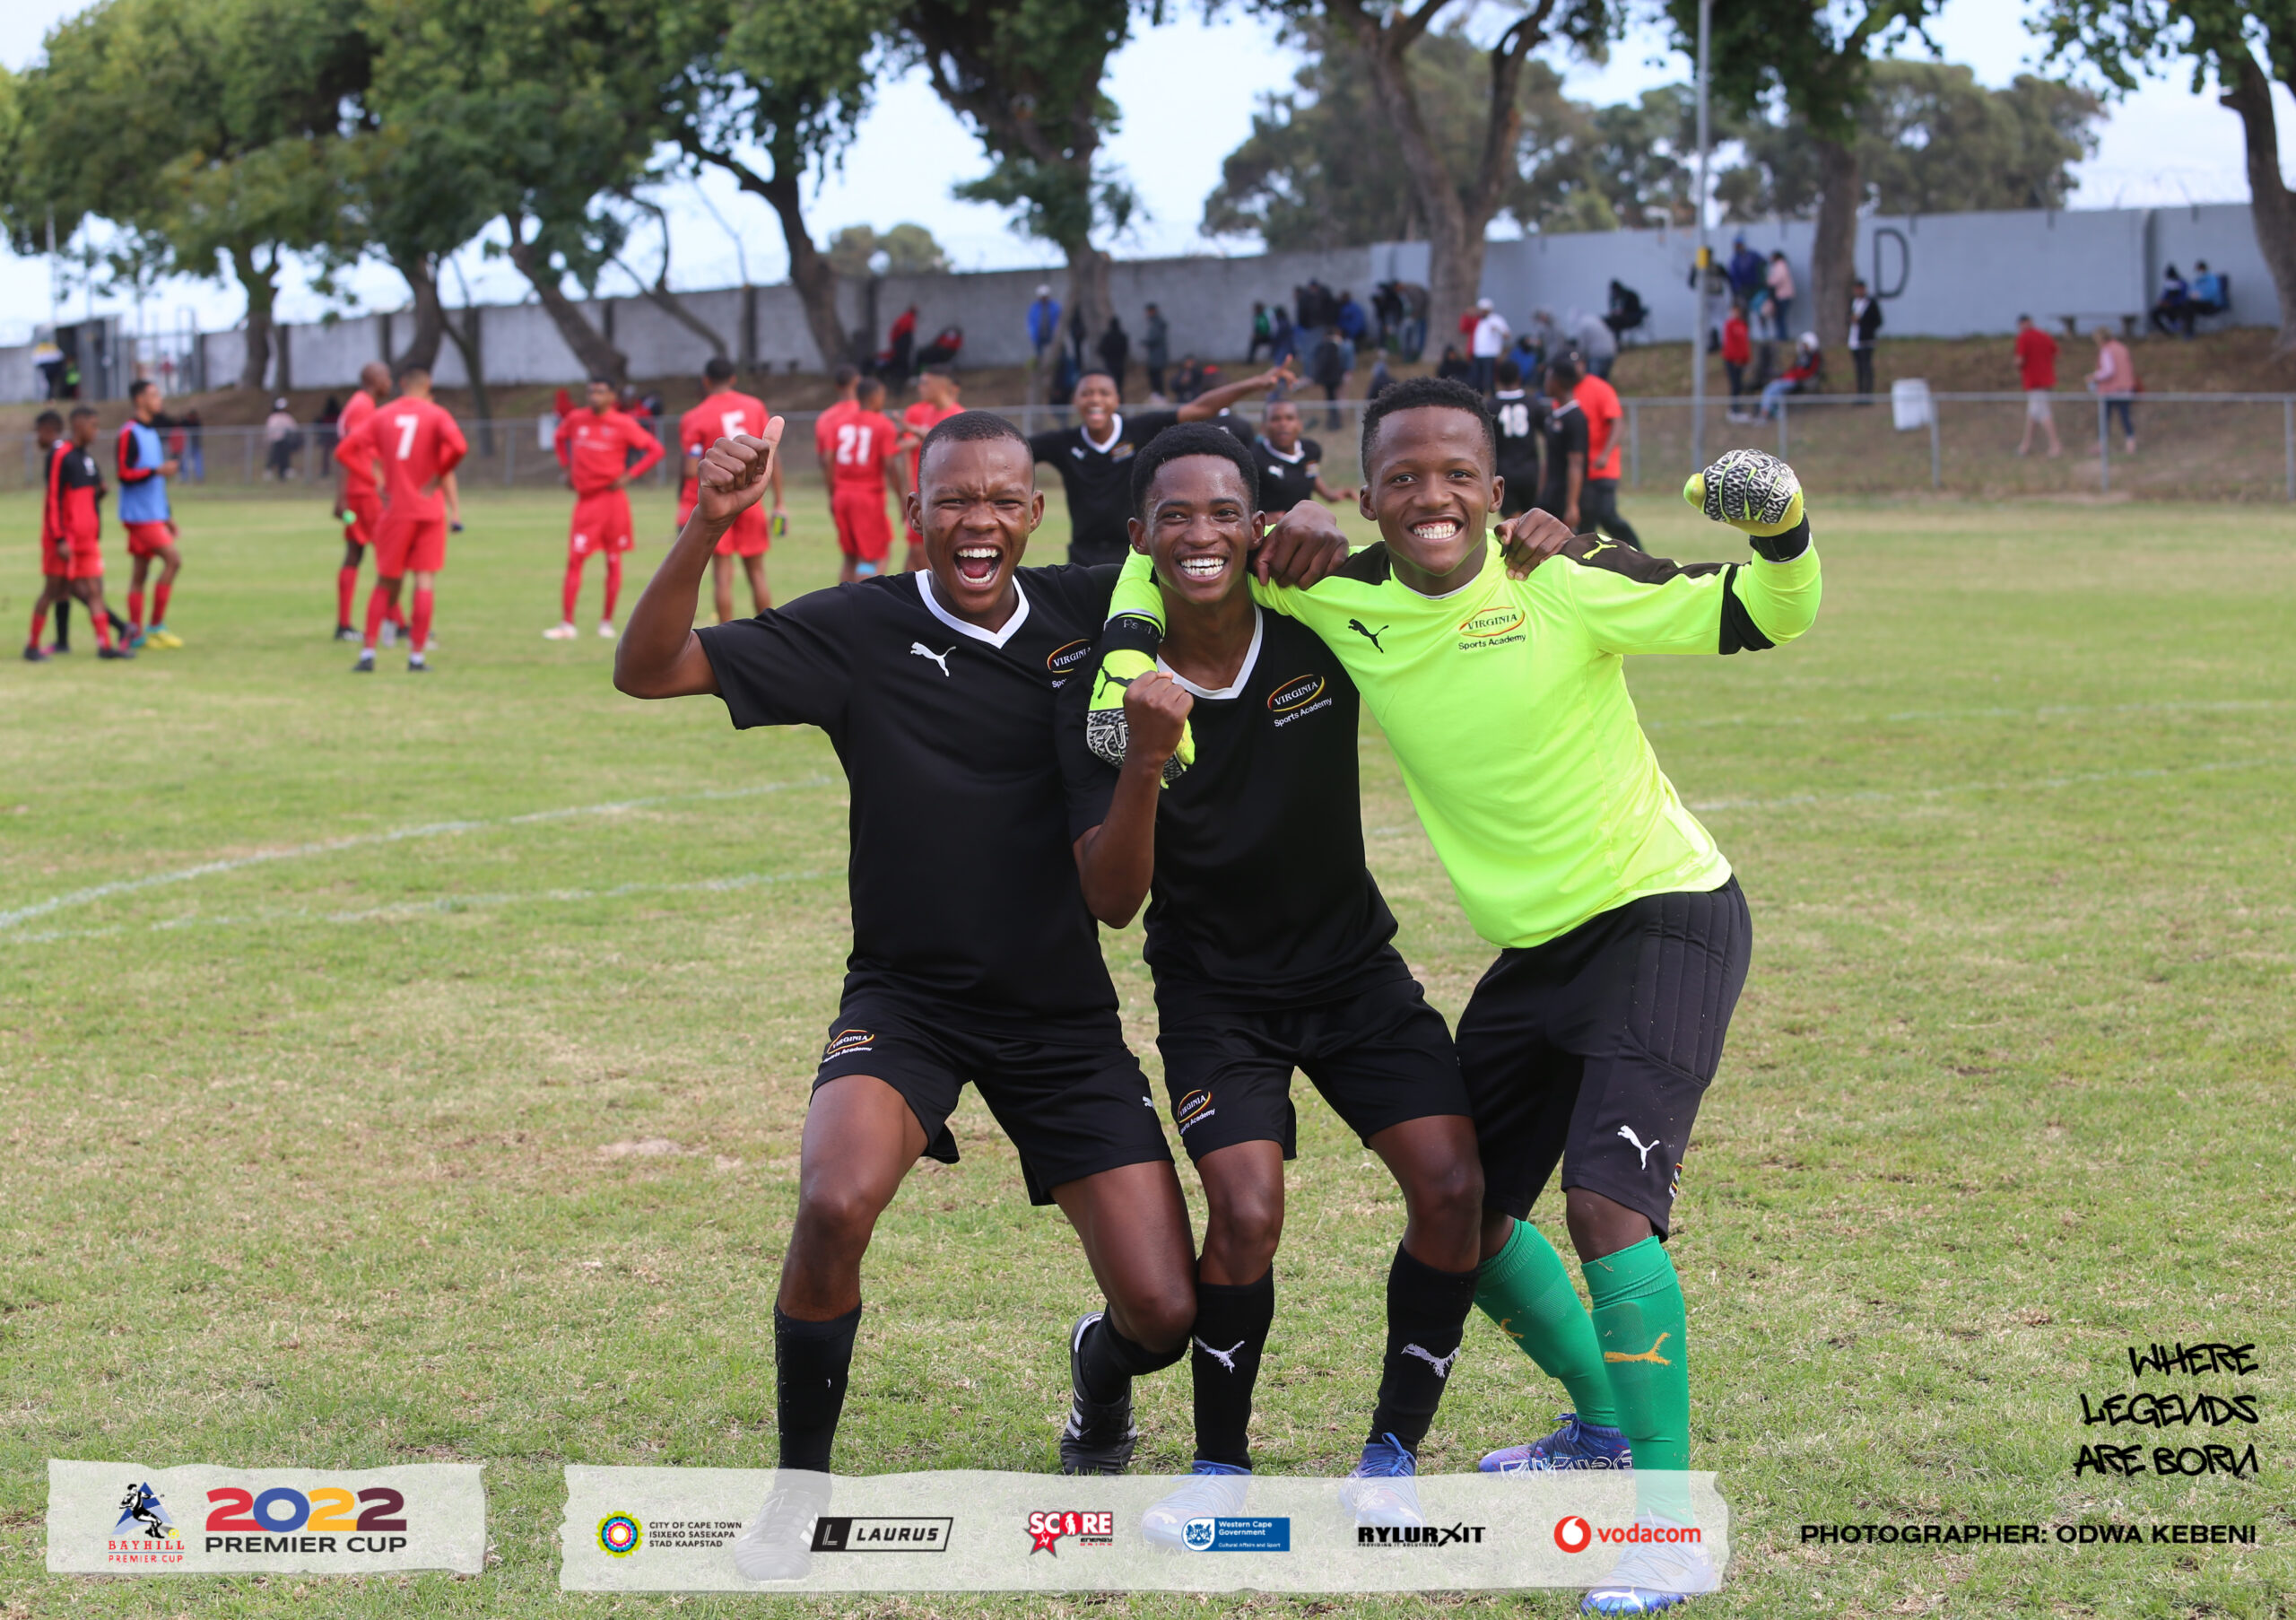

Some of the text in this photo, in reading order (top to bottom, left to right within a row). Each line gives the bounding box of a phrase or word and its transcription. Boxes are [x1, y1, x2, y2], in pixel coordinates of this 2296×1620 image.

[1874, 227, 1911, 300] D
[395, 414, 418, 460] 7
[837, 423, 872, 465] 21
[1468, 614, 1518, 630] VIRGINIA
[1458, 634, 1526, 650] Sports Academy
[1274, 682, 1318, 705] VIRGINIA
[1274, 697, 1333, 727] Sports Academy
[1190, 1108, 1215, 1125] Academy
